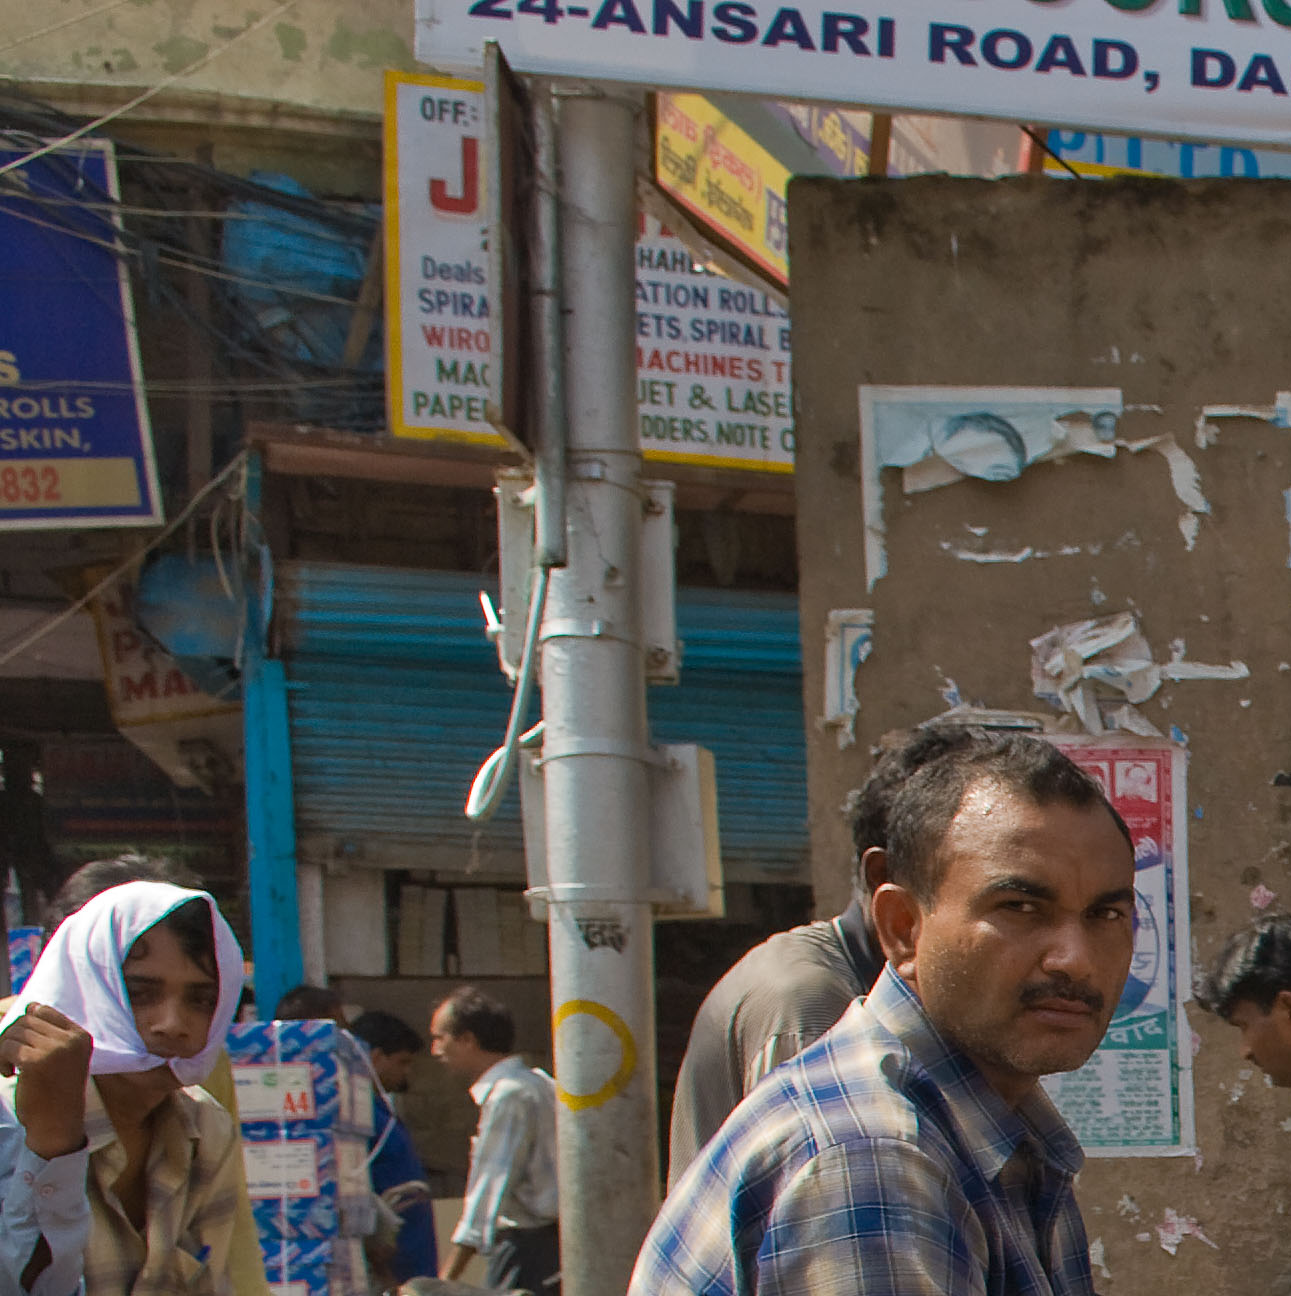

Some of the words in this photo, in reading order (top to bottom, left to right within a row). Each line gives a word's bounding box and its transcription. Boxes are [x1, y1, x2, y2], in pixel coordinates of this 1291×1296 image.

[929, 22, 1160, 93] ROAD,
[421, 255, 486, 284] Deals
[421, 325, 491, 352] WIRO
[691, 320, 770, 351] SPIRAL
[689, 384, 717, 411] &
[0, 428, 91, 452] SKIN,
[716, 421, 771, 450] NOTE
[284, 1091, 310, 1113] A4
